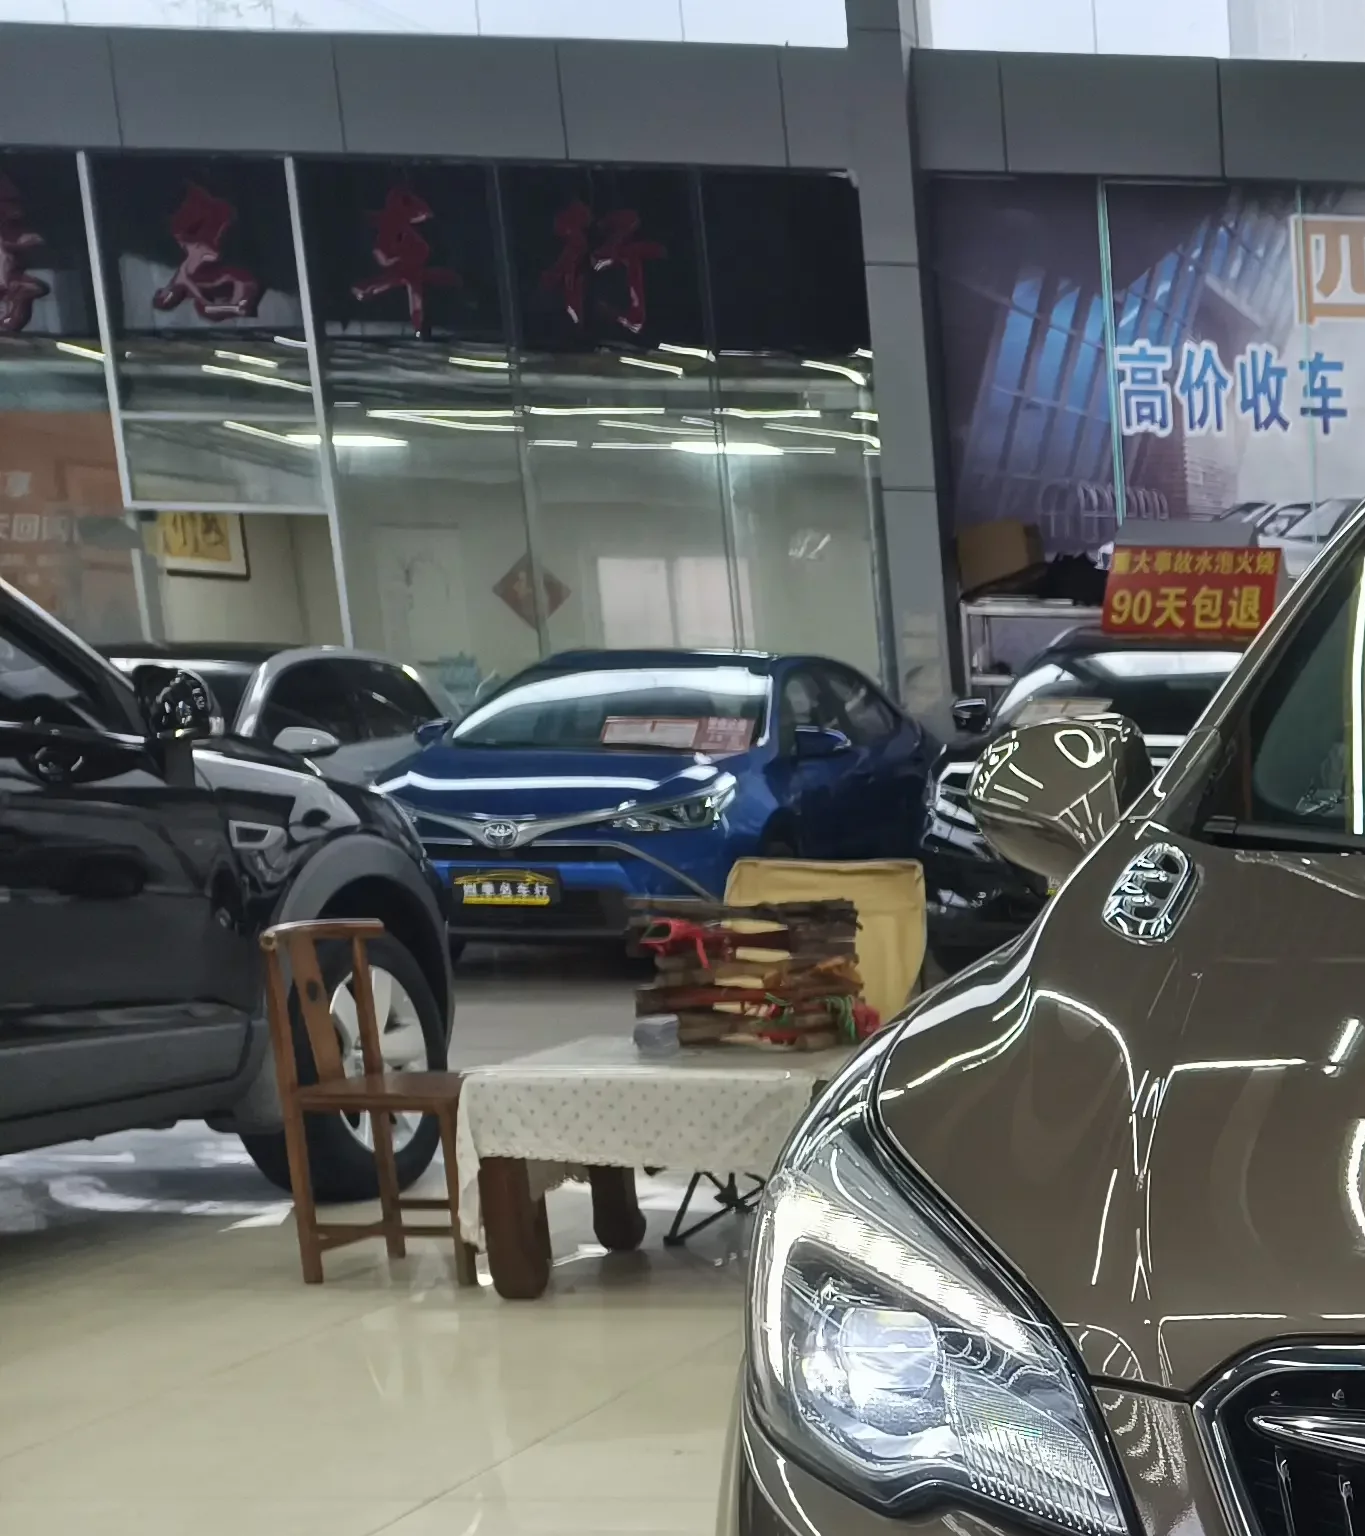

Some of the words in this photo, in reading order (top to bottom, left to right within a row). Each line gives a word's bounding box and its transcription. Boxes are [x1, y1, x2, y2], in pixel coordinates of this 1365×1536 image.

[1116, 342, 1347, 436] 高价收车
[1110, 585, 1262, 629] 90天包退
